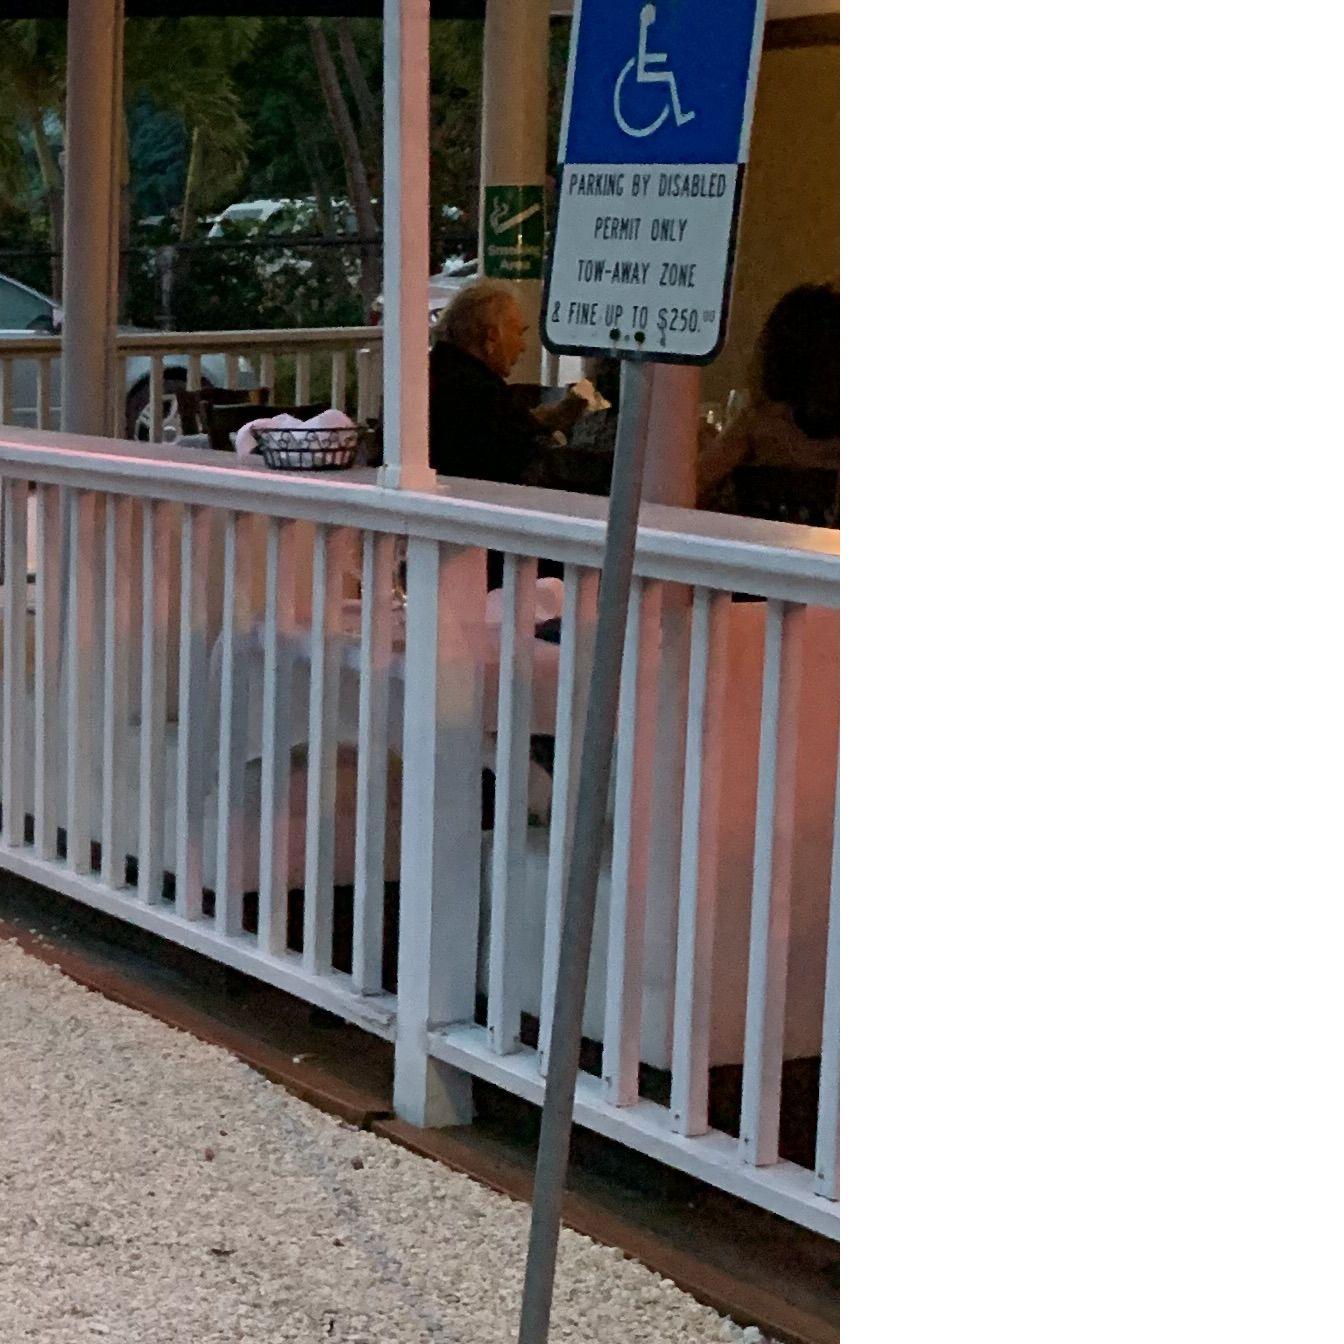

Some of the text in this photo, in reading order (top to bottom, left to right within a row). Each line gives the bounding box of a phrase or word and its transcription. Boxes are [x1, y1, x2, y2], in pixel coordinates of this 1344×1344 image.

[568, 173, 726, 198] PARKING BY DISABLED
[593, 216, 688, 243] PERMIT ONLY
[577, 258, 697, 288] TOW-AWAY ZONE
[551, 300, 561, 324] &
[567, 301, 599, 327] FINE
[604, 303, 624, 328] UP
[631, 305, 648, 330] TO
